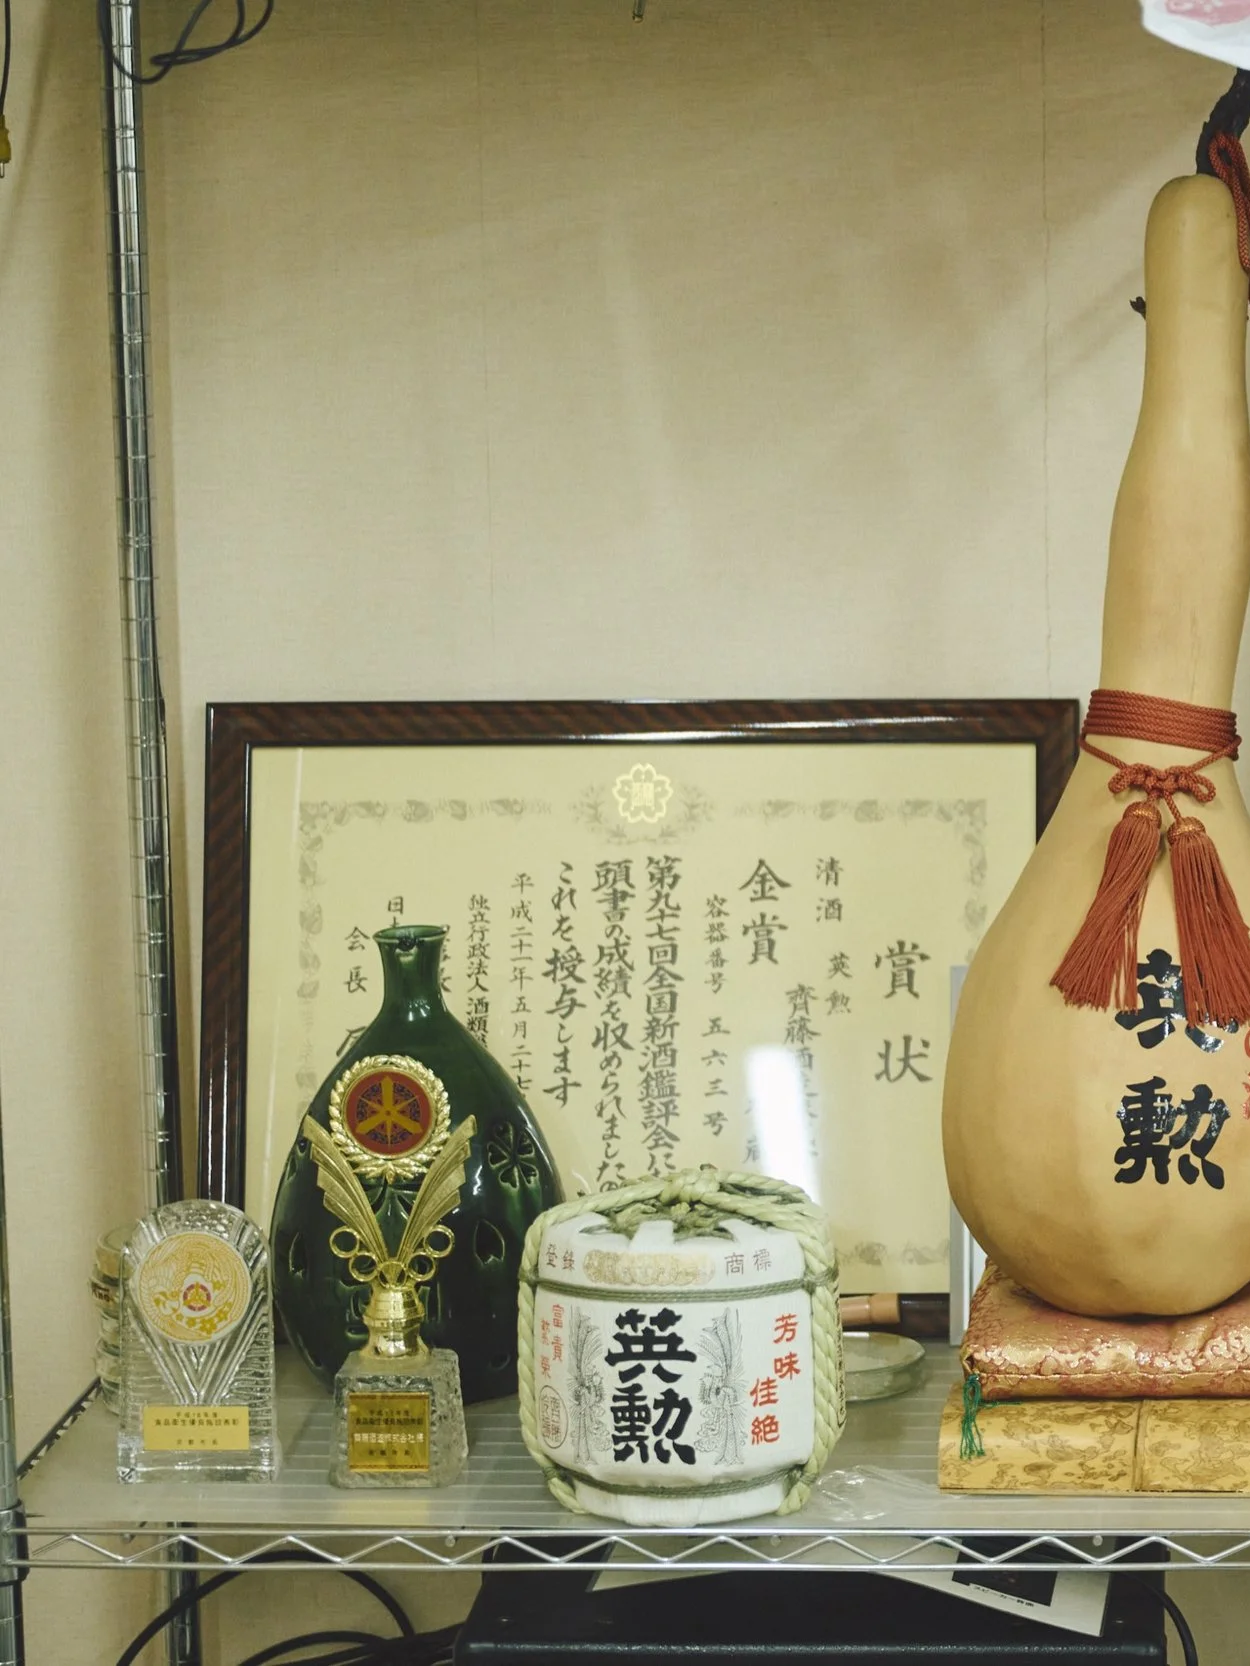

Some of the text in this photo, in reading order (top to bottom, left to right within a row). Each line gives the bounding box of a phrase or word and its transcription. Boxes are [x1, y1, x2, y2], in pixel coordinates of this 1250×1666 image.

[344, 926, 370, 994] 会長
[705, 894, 730, 994] 容器番号
[738, 858, 791, 966] 金賞
[815, 856, 844, 923] 清酒
[510, 873, 534, 1098] 平成二十一年五月二十七
[542, 861, 587, 1109] これを授与します
[638, 855, 684, 1176] 第九十七回全国新酒鑑評会に
[875, 940, 932, 1083] 賞状
[605, 1307, 697, 1465] 英勲
